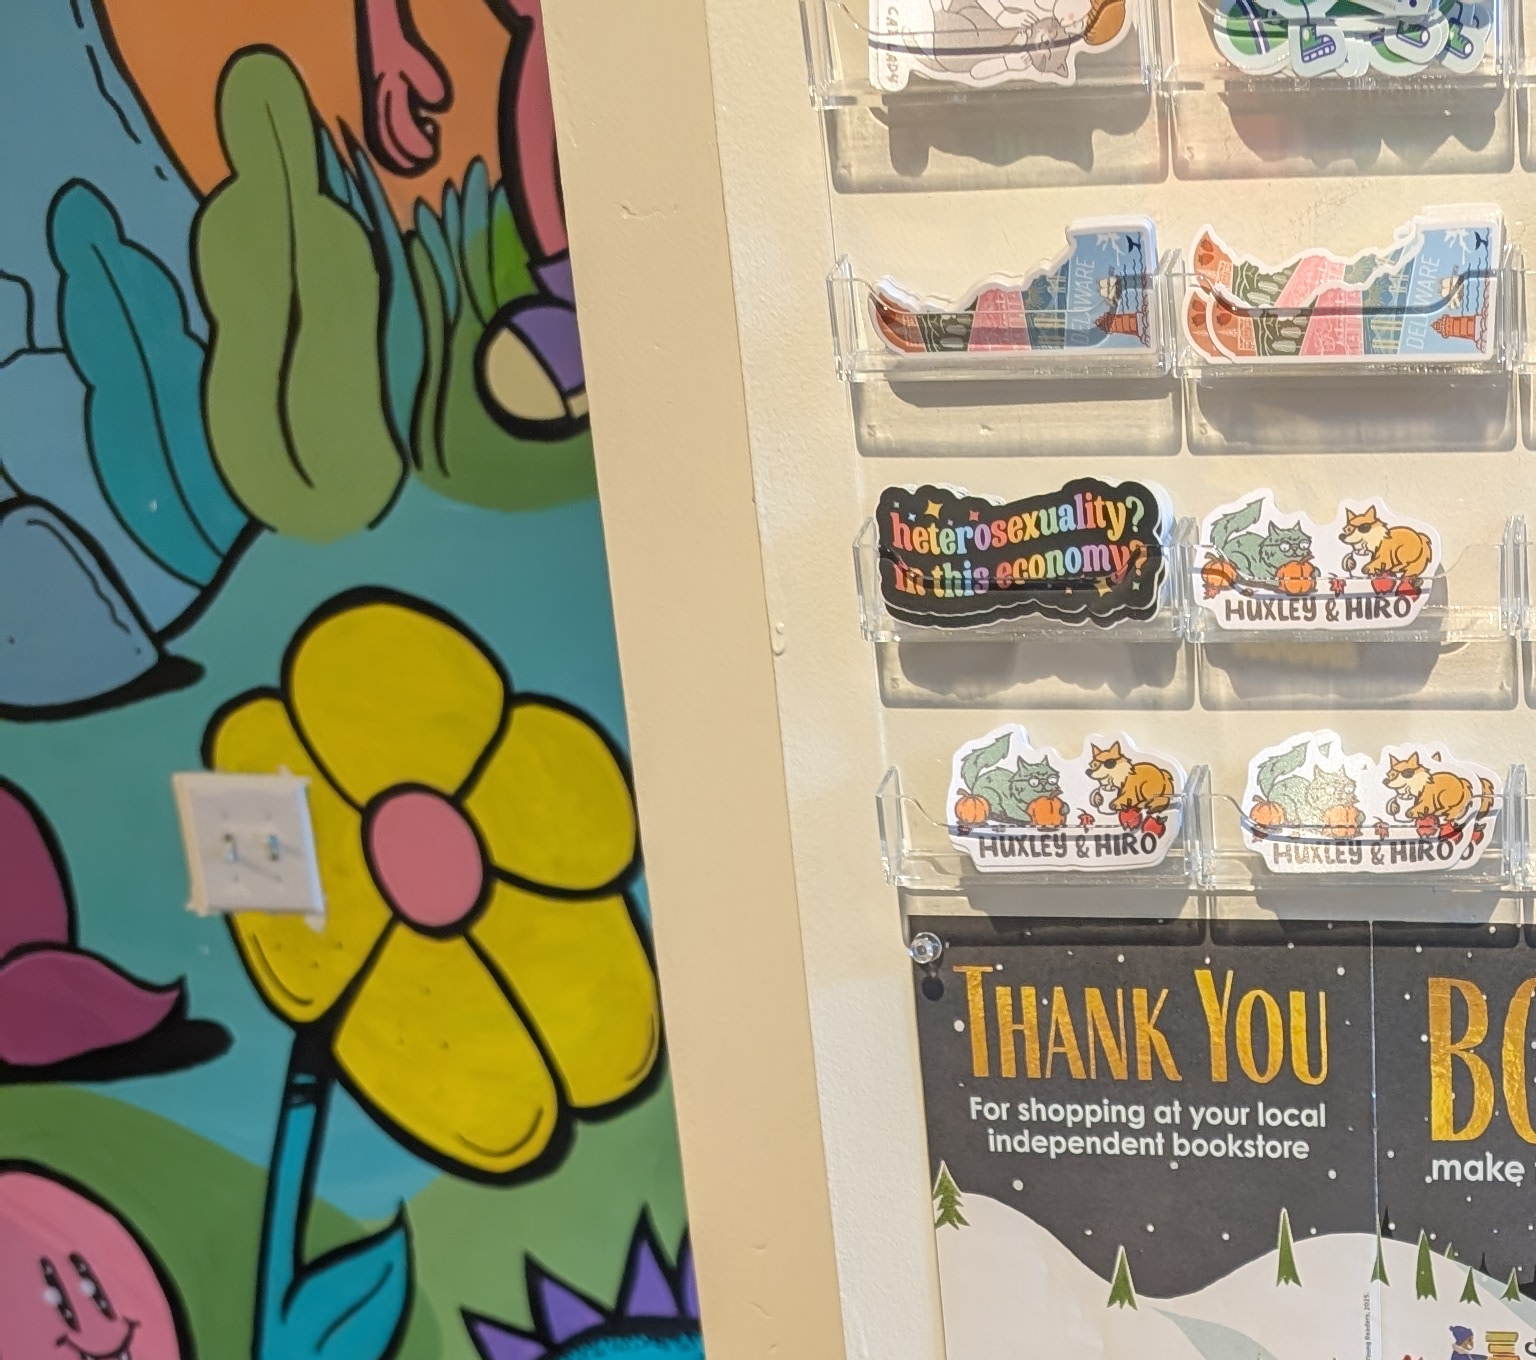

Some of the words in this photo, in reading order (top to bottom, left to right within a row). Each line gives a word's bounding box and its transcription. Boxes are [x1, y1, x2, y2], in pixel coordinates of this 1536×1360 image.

[1065, 256, 1096, 350] DELAWARE
[1406, 252, 1440, 351] DELAWARE
[892, 495, 1145, 555] heterosexuality?
[894, 563, 925, 594] in
[933, 556, 990, 597] this
[996, 541, 1148, 590] economy?
[1225, 599, 1317, 622] HUXLEY
[1324, 603, 1340, 622] &
[1345, 596, 1412, 620] HIRO
[970, 1096, 1009, 1121] For
[1018, 1098, 1145, 1130] shopping
[1154, 1101, 1181, 1125] at
[1191, 1104, 1250, 1130] your
[1257, 1102, 1327, 1128] local
[988, 1130, 1166, 1159] independent
[1172, 1133, 1309, 1159] bookstore
[1431, 1153, 1524, 1182] make
